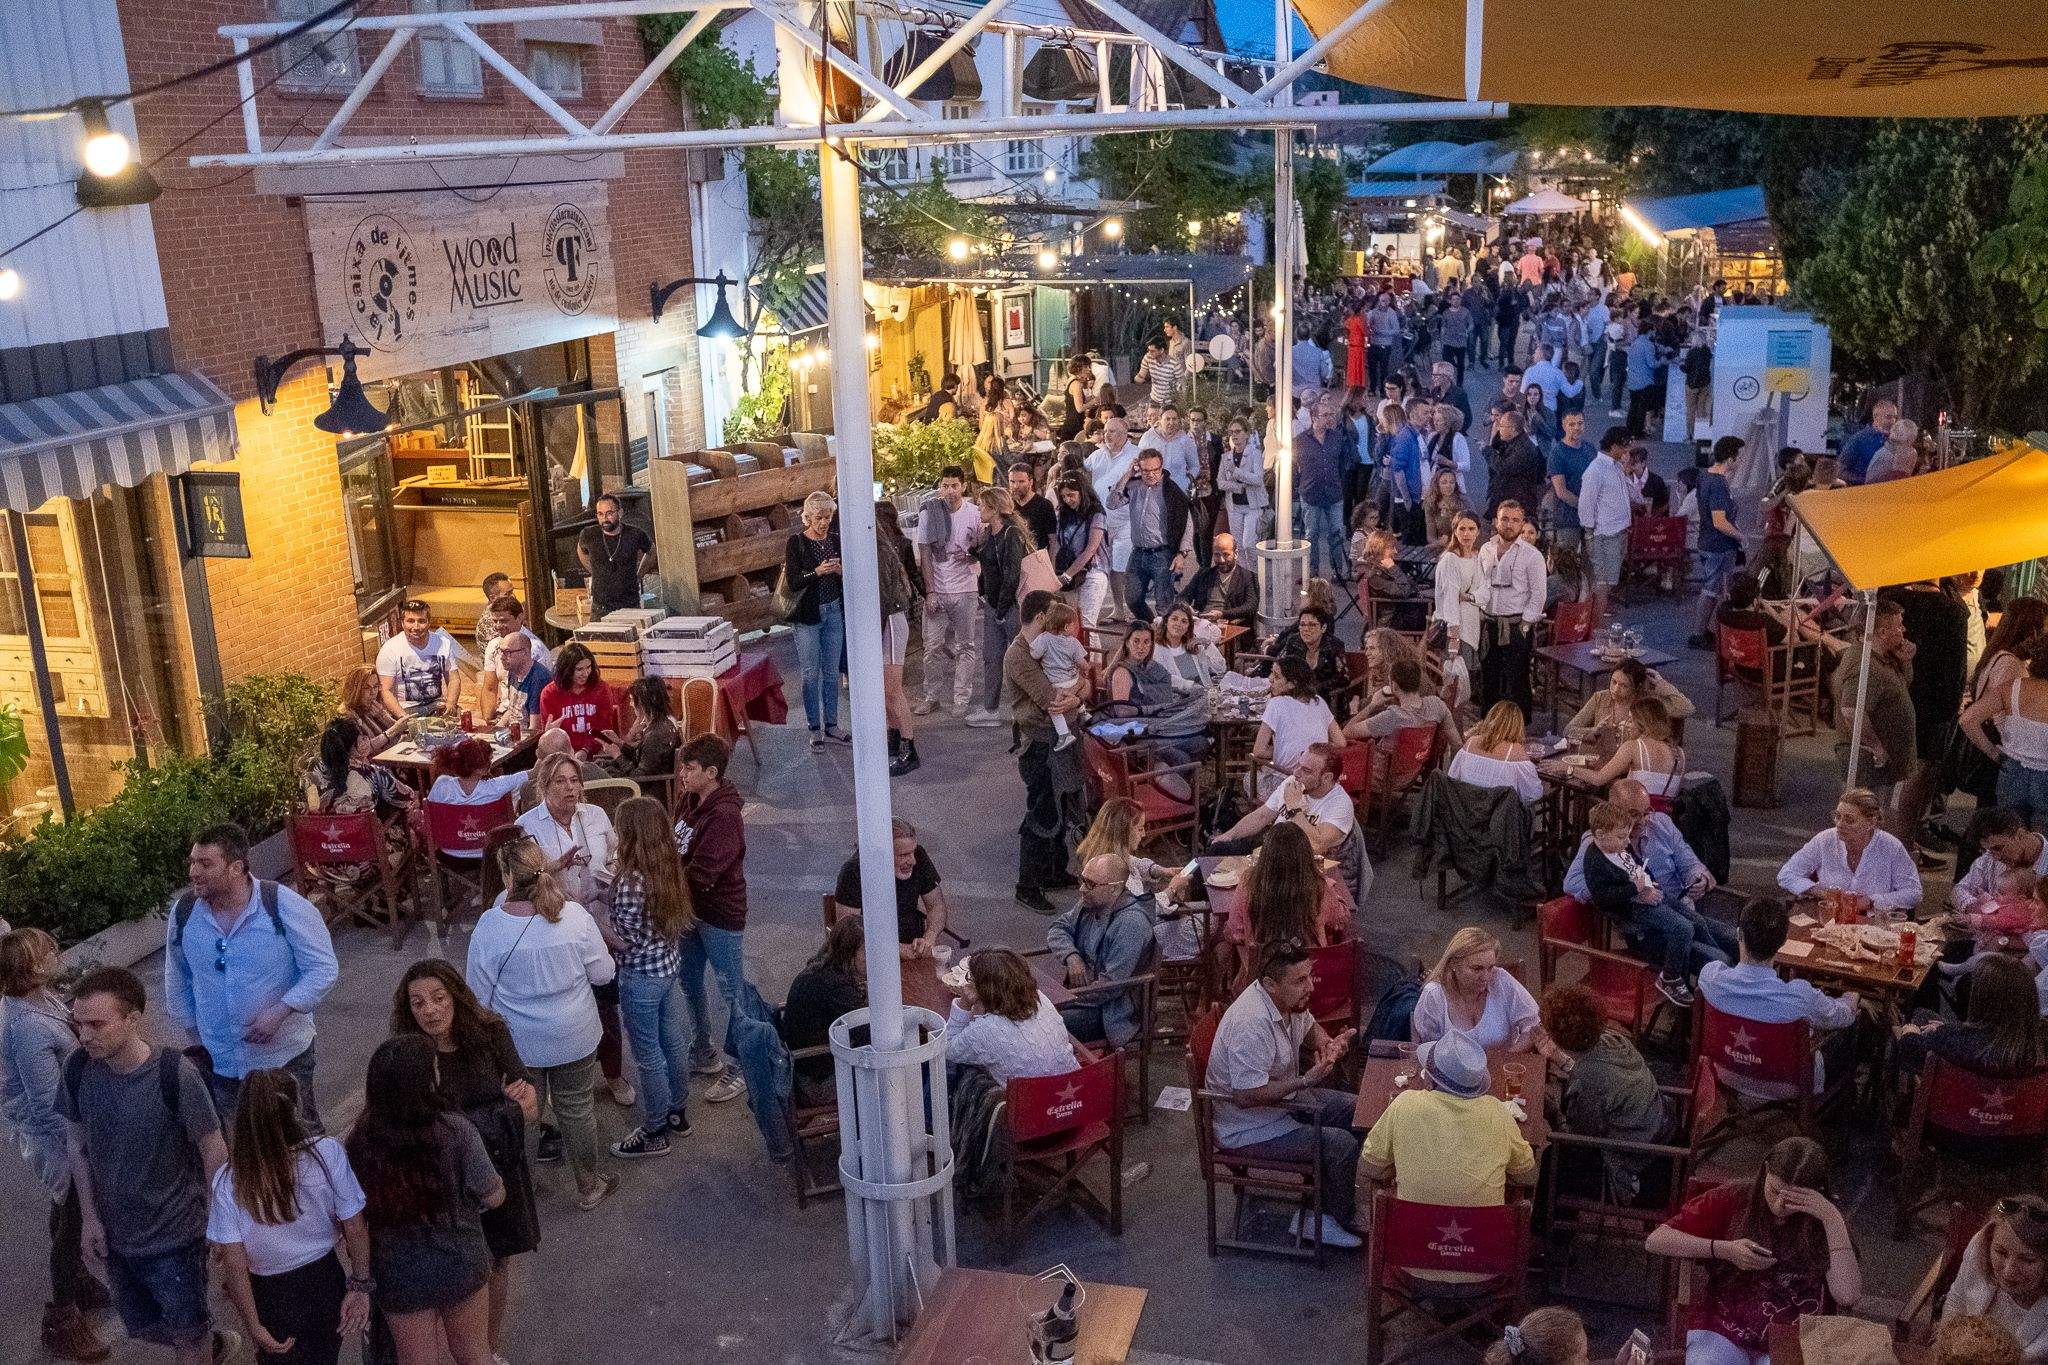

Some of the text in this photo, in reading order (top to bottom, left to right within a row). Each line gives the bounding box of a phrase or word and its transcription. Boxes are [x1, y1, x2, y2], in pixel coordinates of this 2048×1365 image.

[350, 238, 367, 313] caixa
[370, 225, 389, 246] de
[457, 830, 486, 839] Estrella
[1046, 1100, 1083, 1116] Estrella
[1427, 1241, 1475, 1253] Estrella
